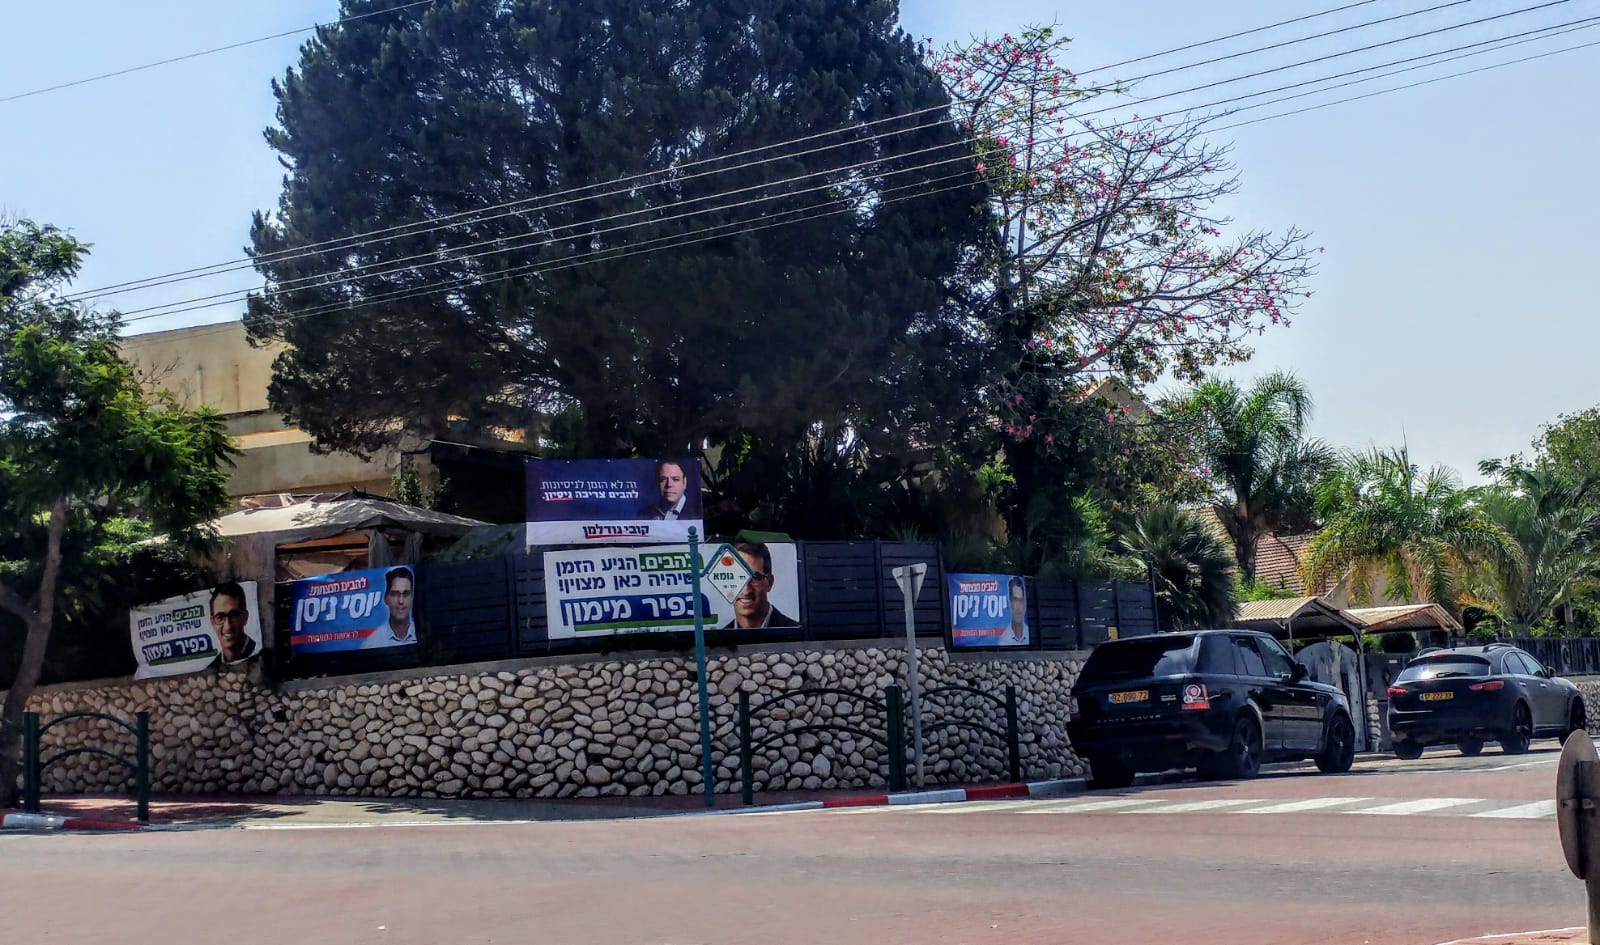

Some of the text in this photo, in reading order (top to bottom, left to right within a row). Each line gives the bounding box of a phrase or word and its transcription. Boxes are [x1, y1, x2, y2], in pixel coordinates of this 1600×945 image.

[610, 480, 623, 489] לא
[541, 490, 639, 501] להבים צריכה ניסיון.
[582, 523, 650, 537] קובי נודלמן
[556, 560, 595, 577] הזמן
[601, 557, 638, 572] הגיע
[341, 577, 366, 591] להבים
[613, 574, 641, 591] כאן
[713, 572, 734, 581] גומא
[558, 577, 606, 594] מצוין!
[295, 591, 382, 631] יוסי ניסן
[565, 598, 632, 627] מימון
[953, 594, 1008, 625] יוסי ניסן
[160, 625, 174, 637] כאן
[176, 620, 202, 632] שיהיה
[144, 636, 208, 662] כפיר מימון
